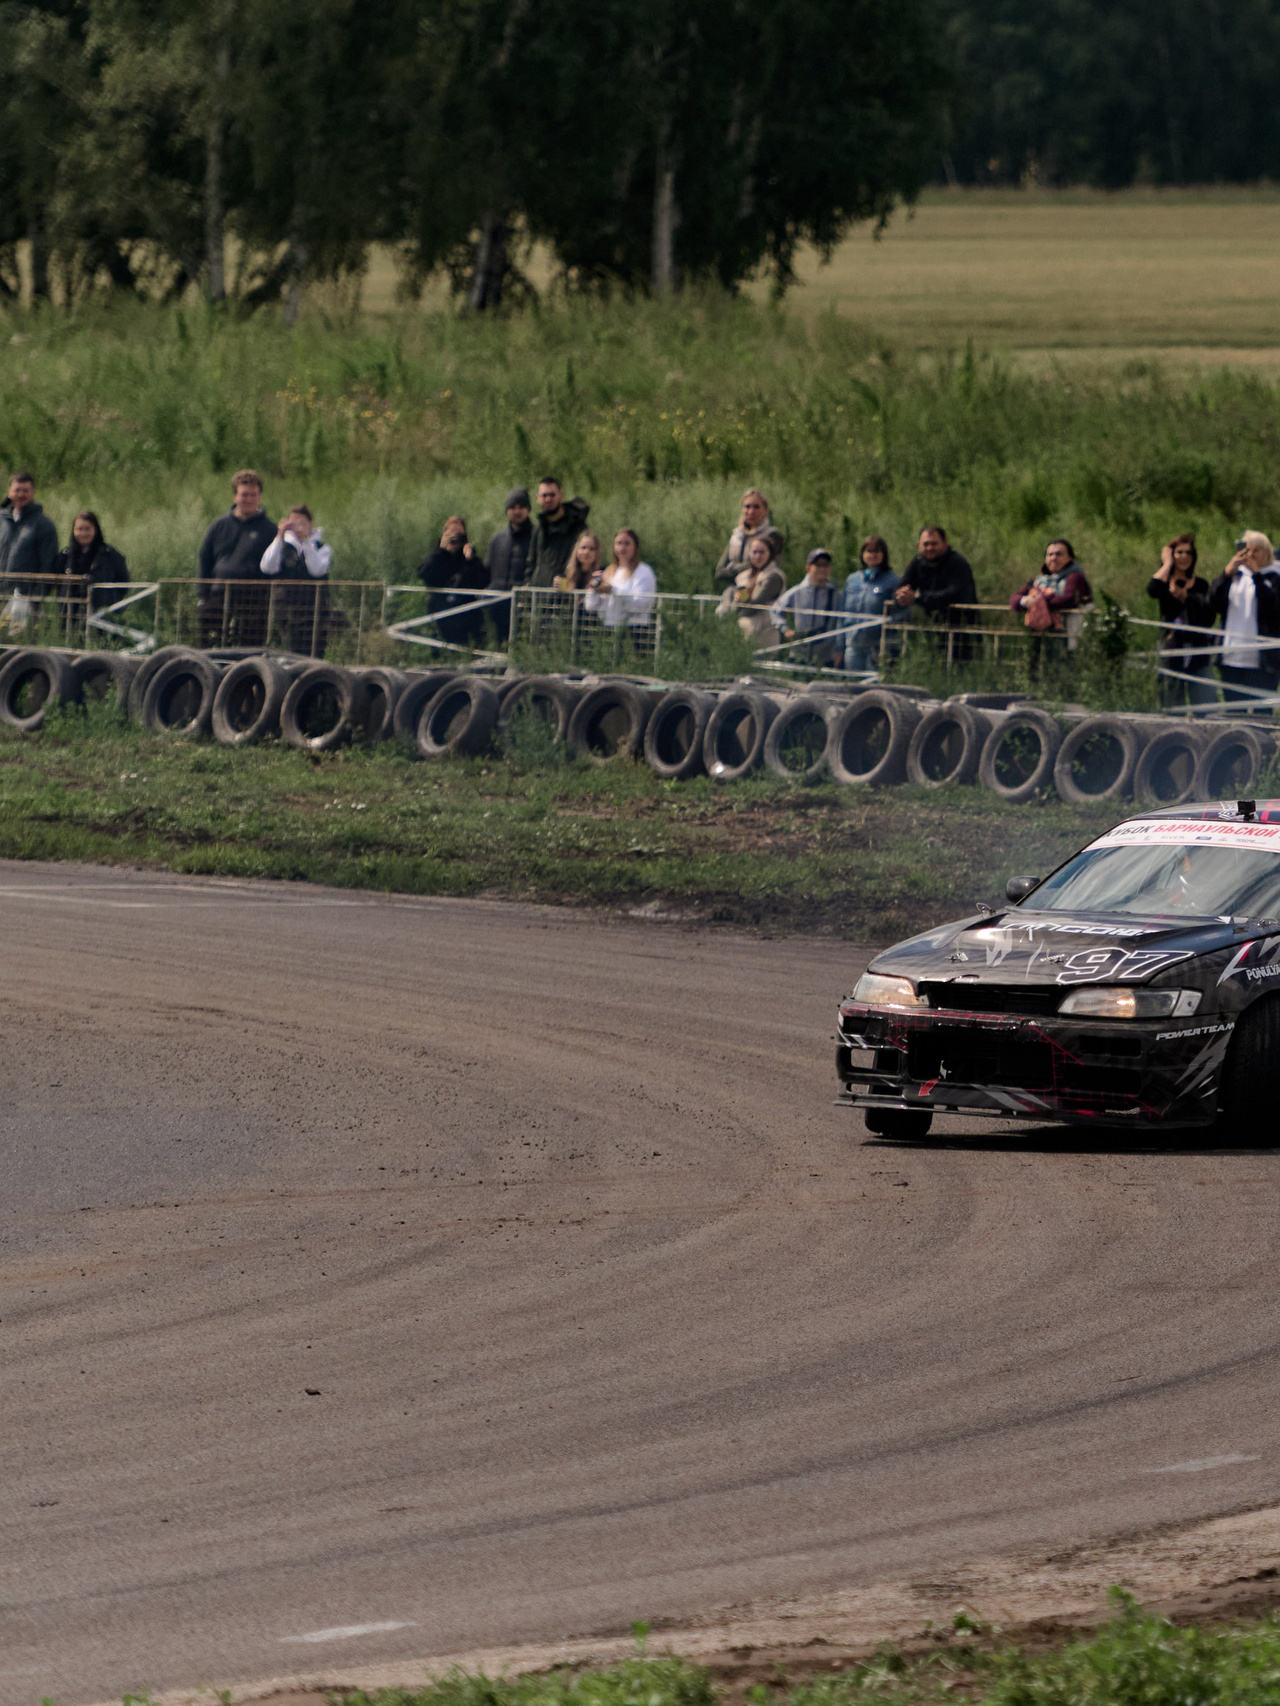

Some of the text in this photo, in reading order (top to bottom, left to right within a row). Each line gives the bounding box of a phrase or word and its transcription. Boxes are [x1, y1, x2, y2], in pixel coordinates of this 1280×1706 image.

[1104, 825, 1155, 838] КУБОК
[1152, 824, 1280, 838] БАРНАУЛЬСКОЙ
[1056, 947, 1197, 984] 97
